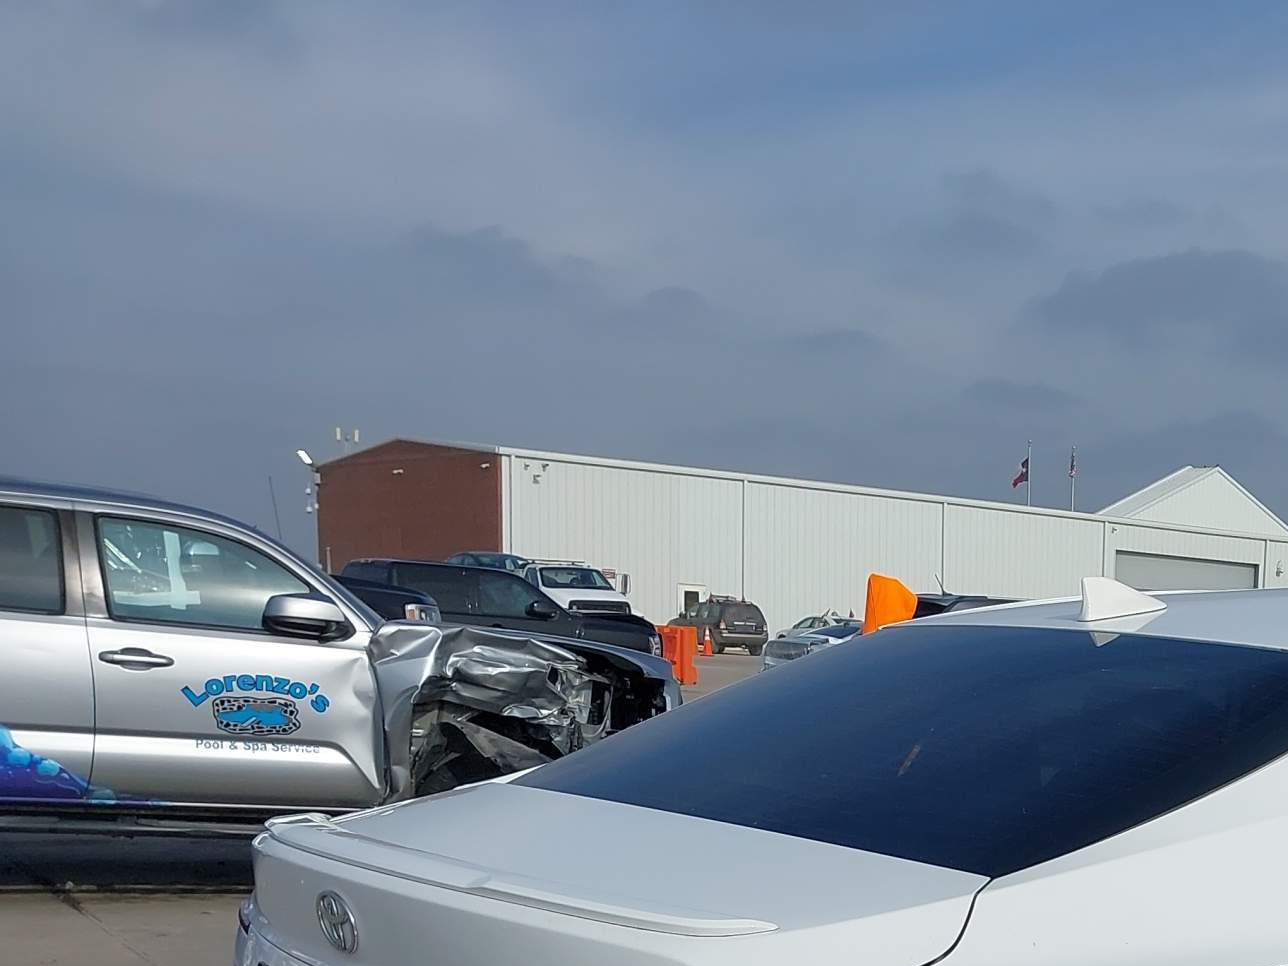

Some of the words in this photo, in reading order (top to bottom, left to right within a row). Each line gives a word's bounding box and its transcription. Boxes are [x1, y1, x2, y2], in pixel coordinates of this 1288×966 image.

[181, 674, 330, 712] Lorenzo's
[195, 738, 224, 749] Pool
[229, 740, 239, 750] &
[243, 740, 268, 754] Spa
[271, 741, 321, 754] Service
